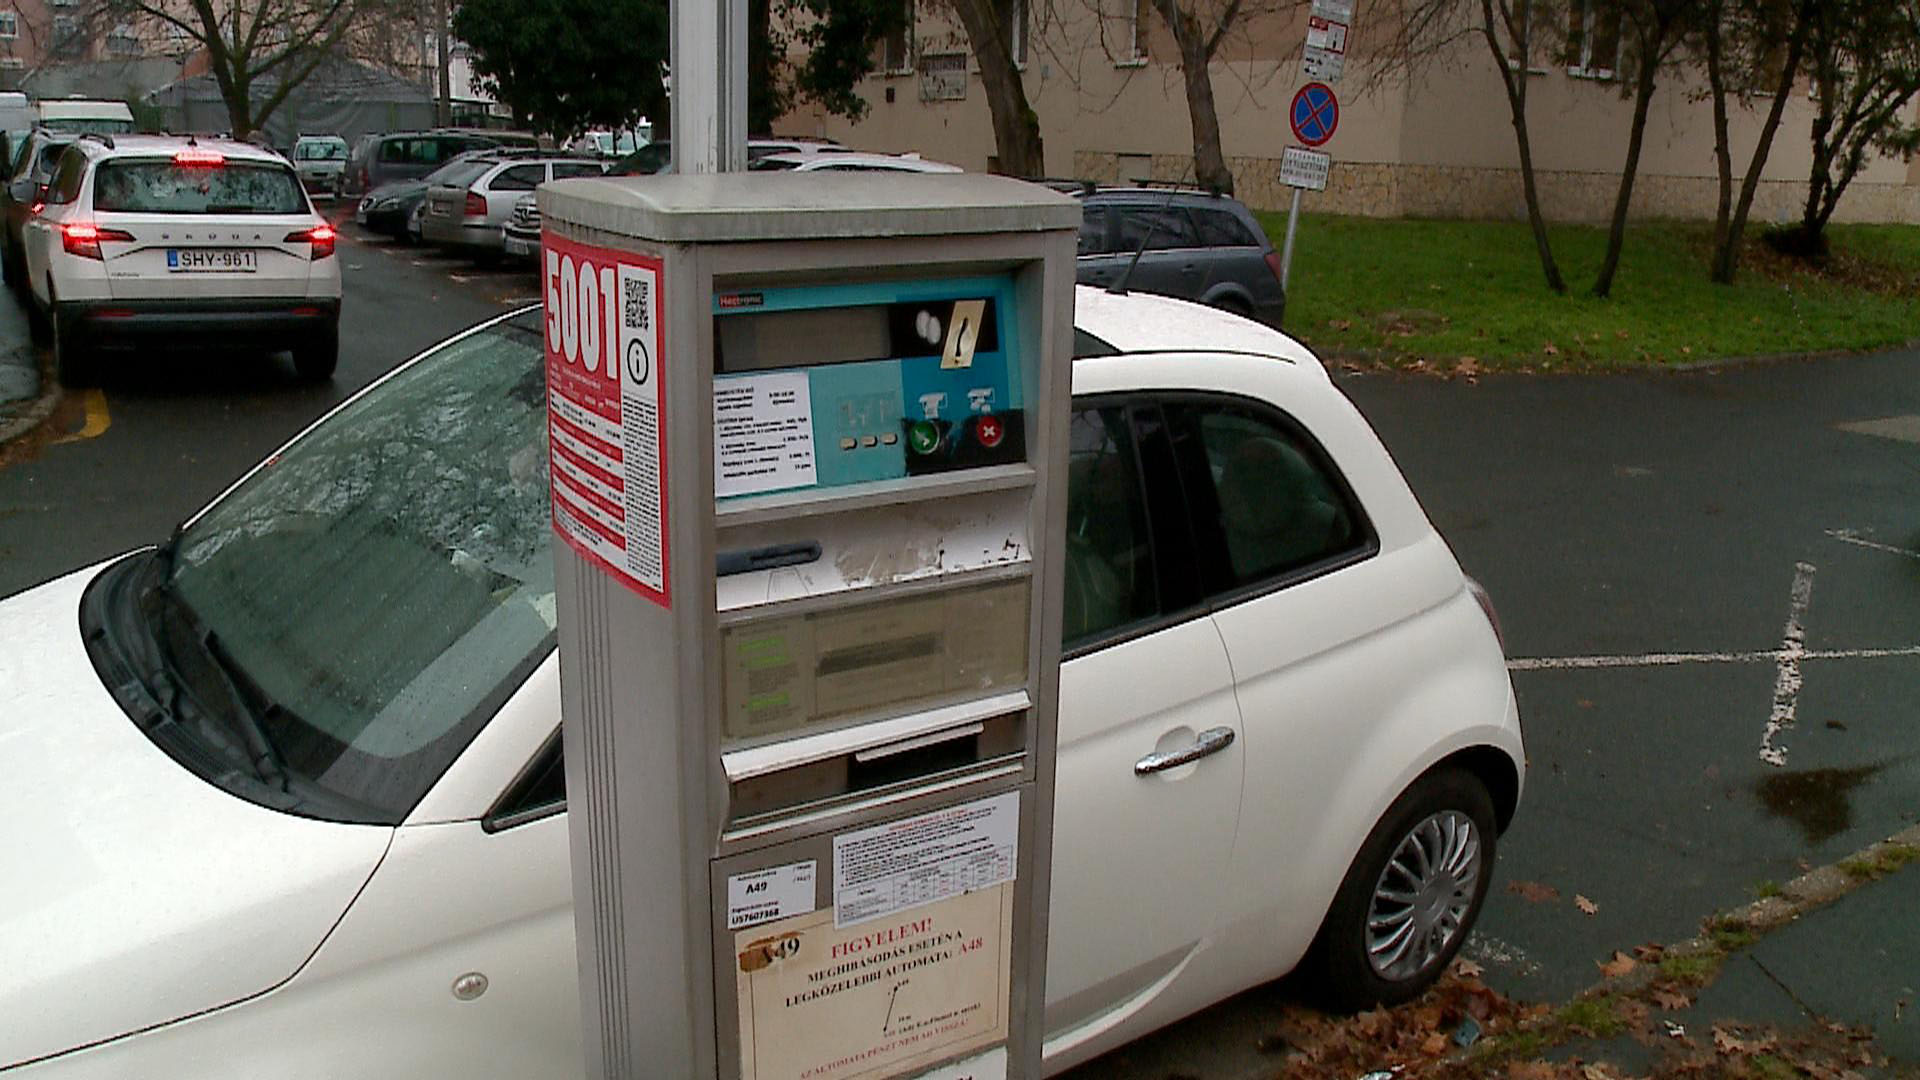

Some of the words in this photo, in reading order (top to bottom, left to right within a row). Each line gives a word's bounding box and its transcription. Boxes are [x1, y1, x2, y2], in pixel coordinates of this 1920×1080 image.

[181, 250, 250, 266] SHY-961
[546, 247, 618, 381] 5001
[746, 881, 767, 895] A49
[832, 918, 933, 959] FIGYELEM!
